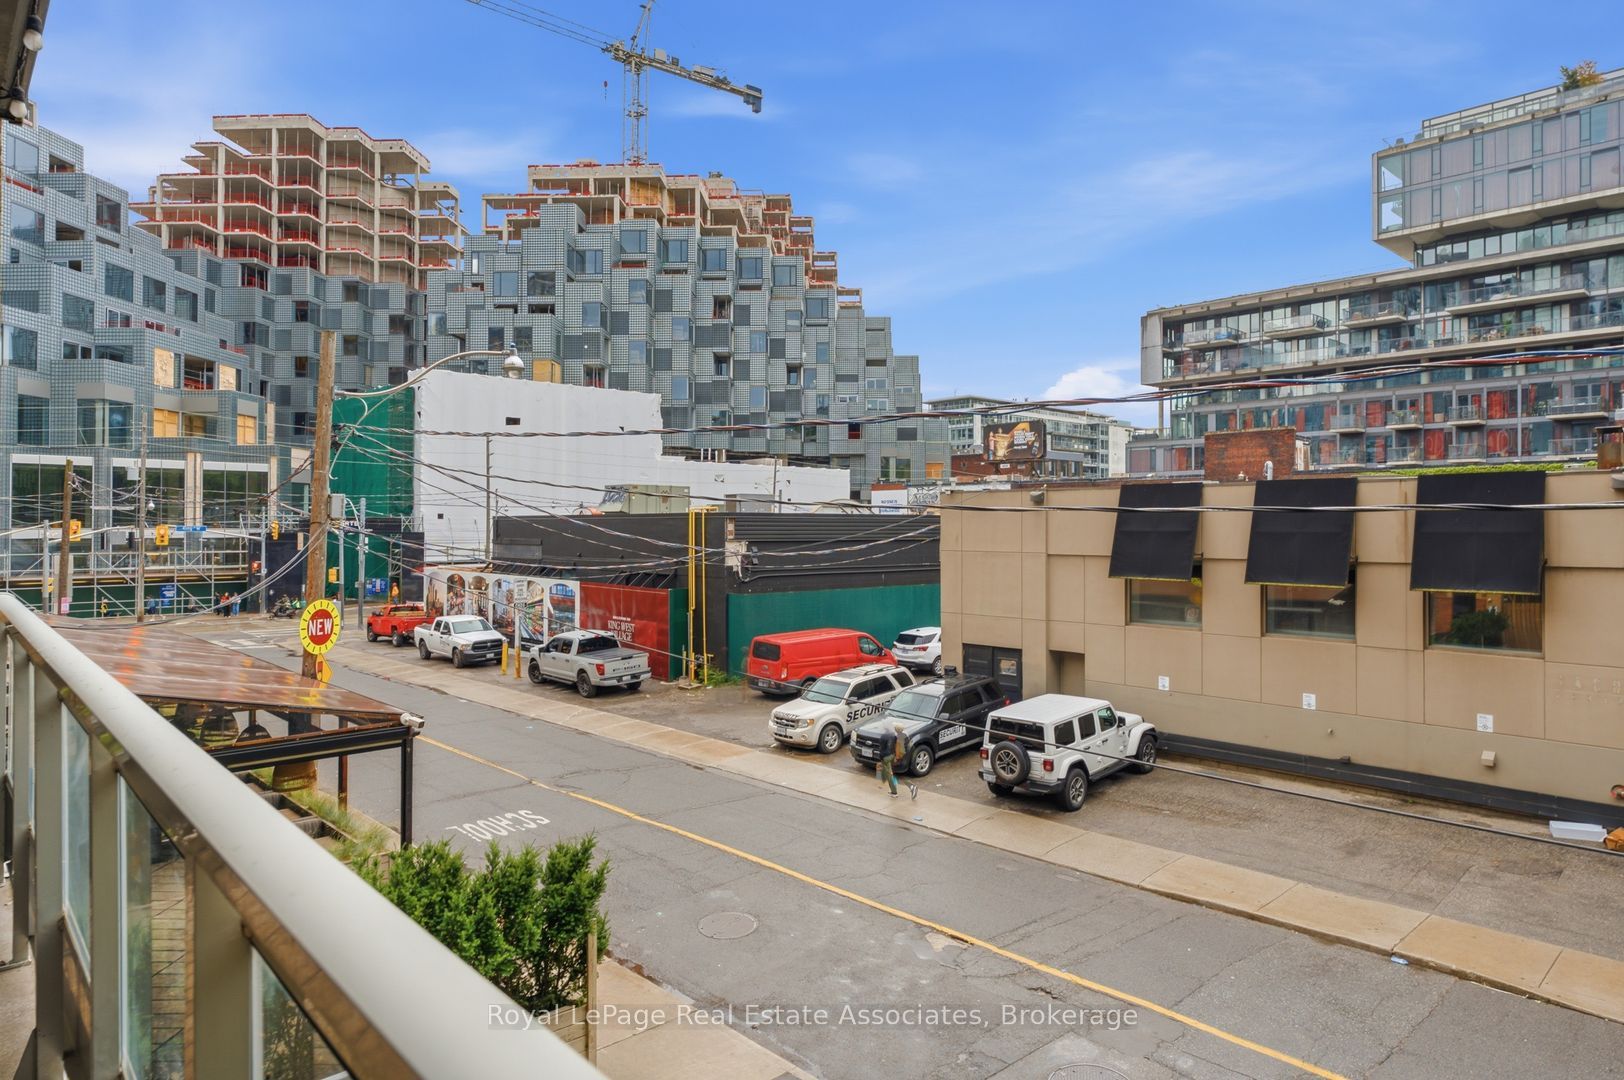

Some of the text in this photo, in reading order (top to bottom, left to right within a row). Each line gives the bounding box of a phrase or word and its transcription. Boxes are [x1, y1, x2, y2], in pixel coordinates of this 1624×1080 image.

[308, 618, 333, 636] NEW
[611, 630, 632, 641] ILLAGE
[445, 810, 551, 842] SCHOOL
